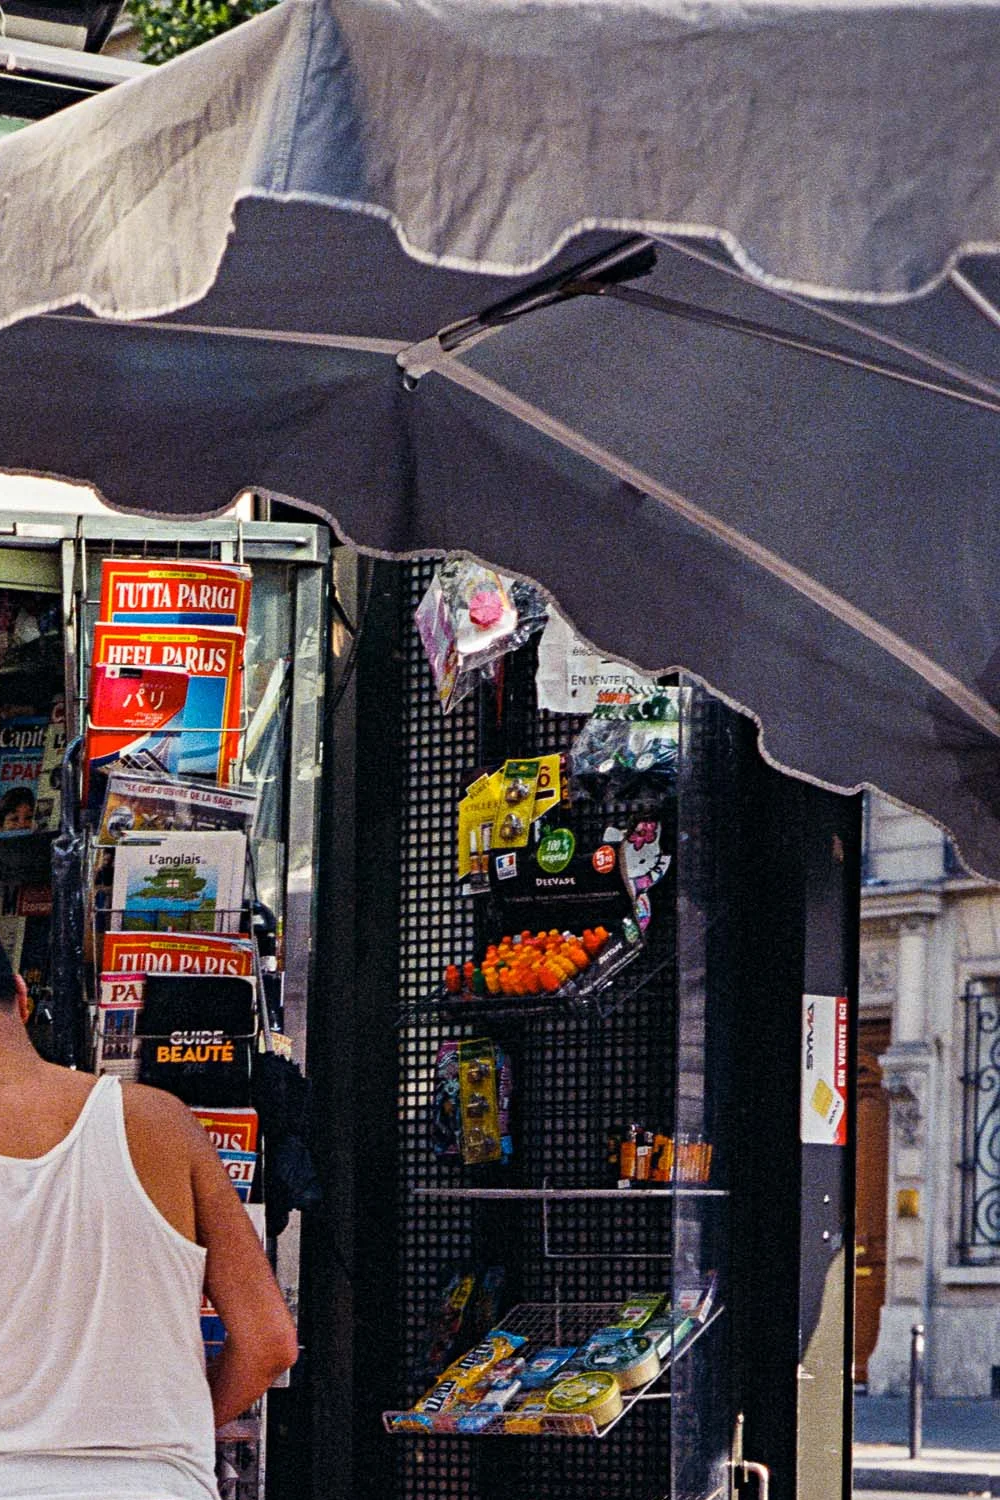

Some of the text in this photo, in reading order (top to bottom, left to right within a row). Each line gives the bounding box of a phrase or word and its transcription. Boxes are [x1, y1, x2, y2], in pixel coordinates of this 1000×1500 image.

[116, 582, 236, 611] TUTTA PARIGI
[148, 853, 201, 868] L'anglais
[169, 1030, 224, 1046] GUIDE
[837, 1003, 847, 1088] EN VENTE ICI
[156, 1040, 235, 1064] BEAUTÉ
